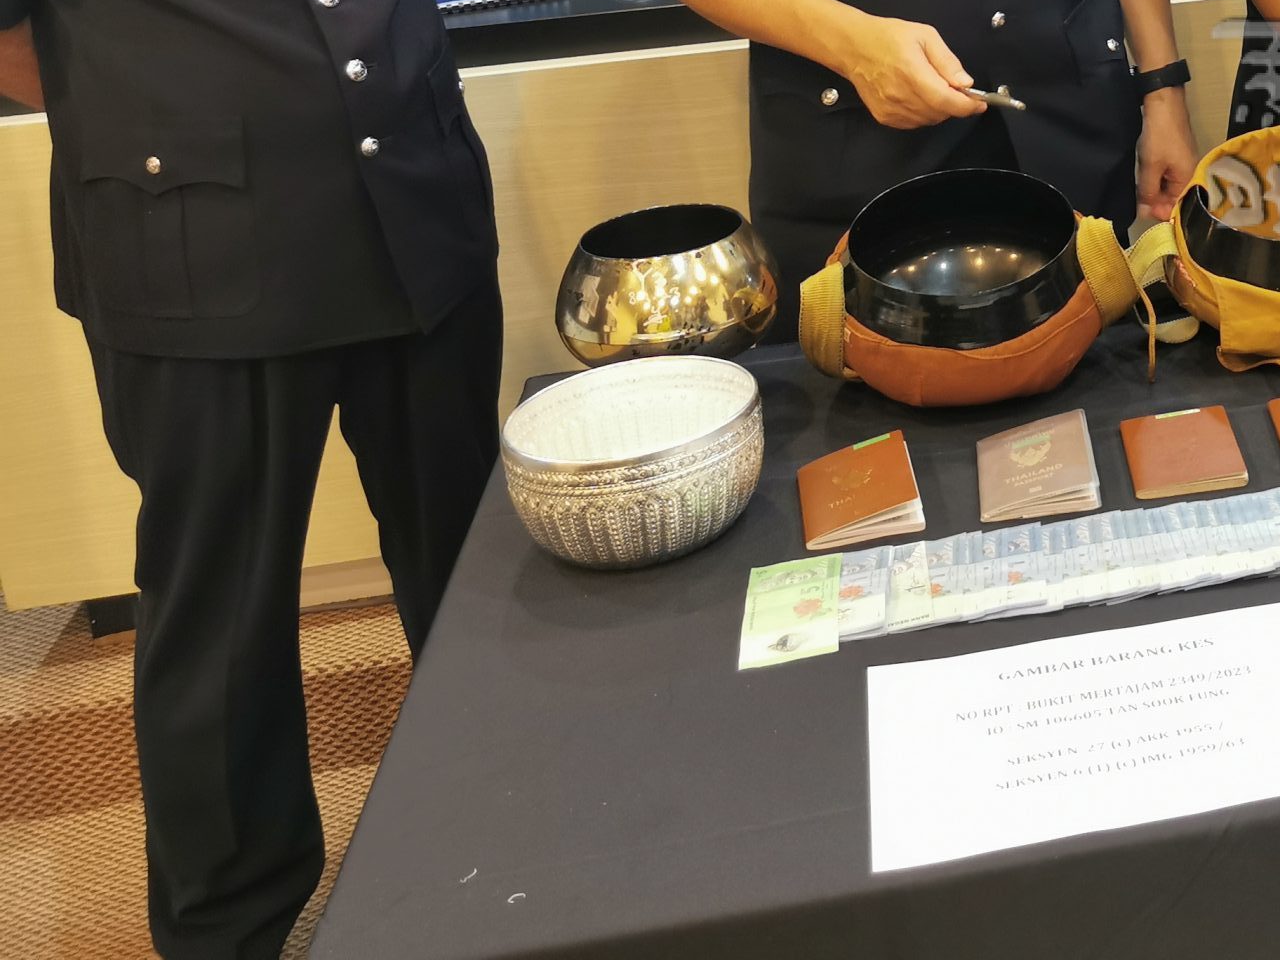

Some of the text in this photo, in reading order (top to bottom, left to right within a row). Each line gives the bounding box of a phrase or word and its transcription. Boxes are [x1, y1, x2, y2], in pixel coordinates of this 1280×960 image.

[1005, 463, 1063, 485] THAILAND
[998, 637, 1214, 681] GAMBAR BARANG KES
[955, 709, 977, 721] NO
[982, 703, 1014, 717] RPT
[1026, 694, 1073, 709] BUKIT
[1079, 679, 1164, 701] MERTAJAM
[1107, 702, 1138, 715] TAN
[1142, 695, 1184, 709] SOOK
[1006, 746, 1078, 766] SEKSYEN
[995, 769, 1067, 789] SEKSYEN
